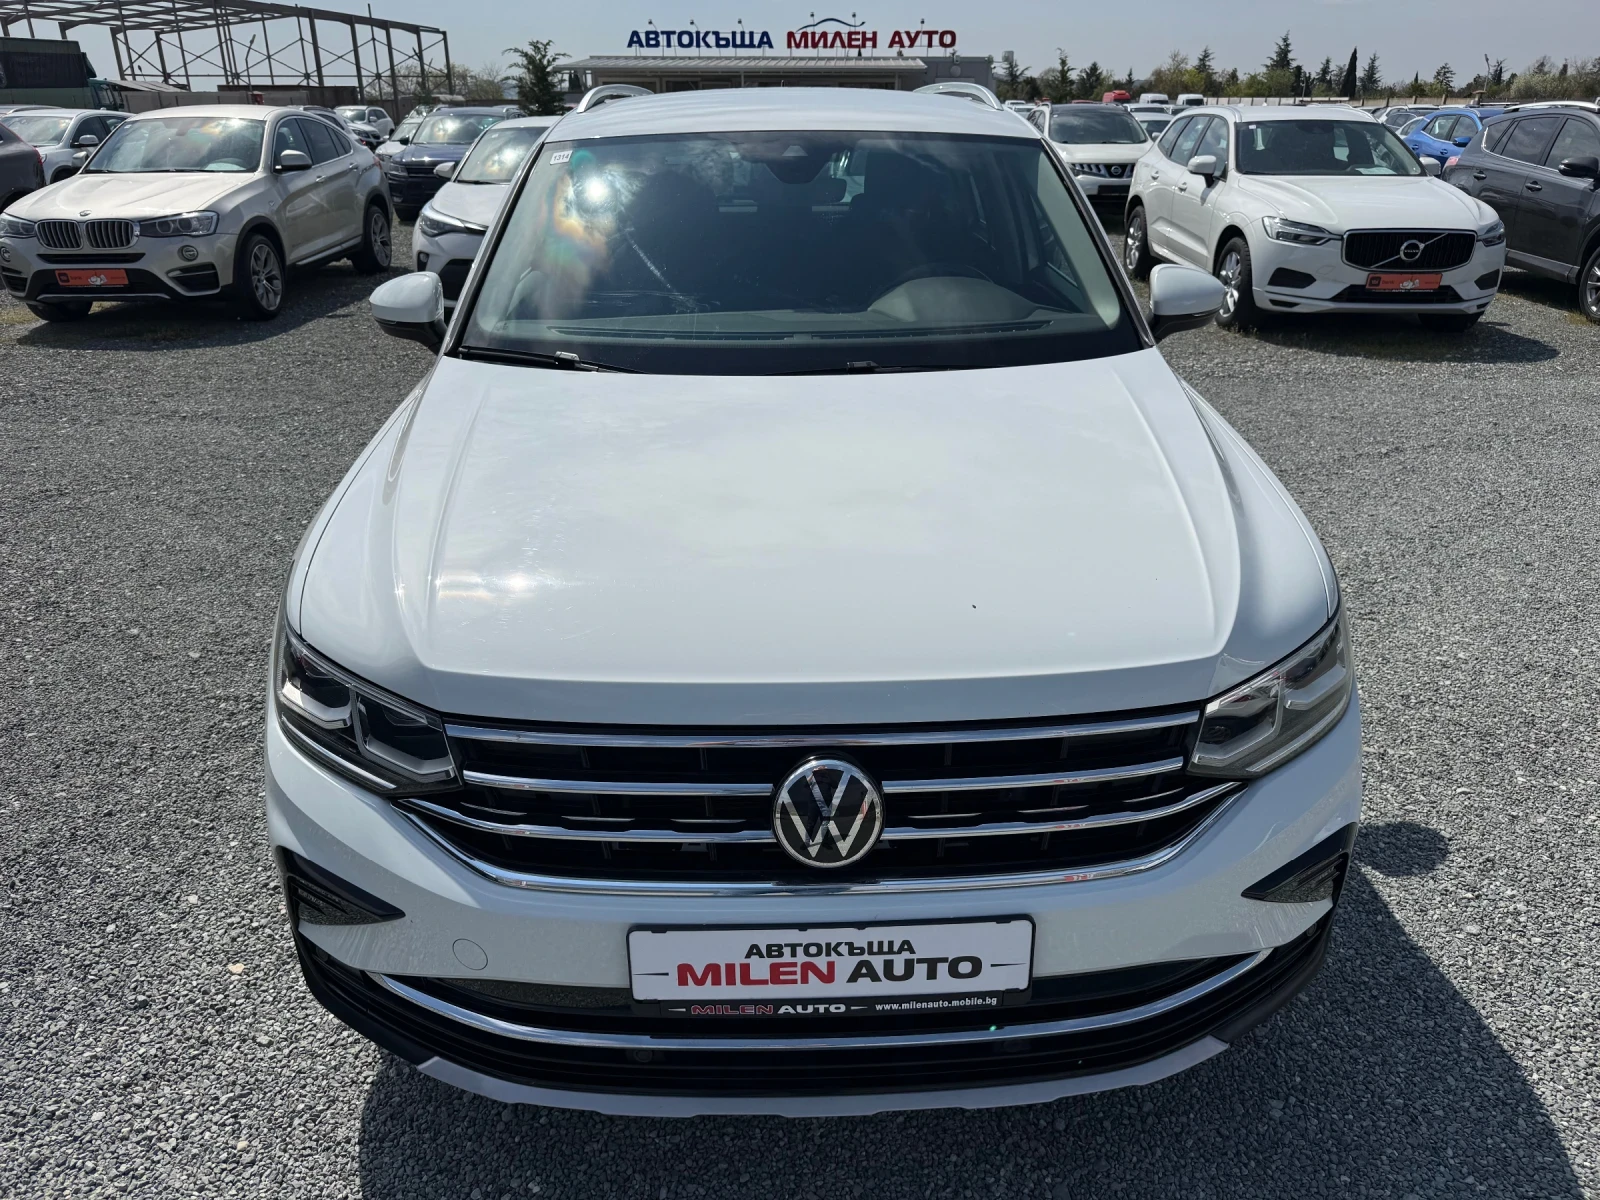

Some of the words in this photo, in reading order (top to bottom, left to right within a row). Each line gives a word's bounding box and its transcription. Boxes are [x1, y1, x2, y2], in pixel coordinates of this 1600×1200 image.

[626, 30, 774, 49] АВТОКЪЩА
[787, 31, 878, 49] МИЛЕН
[888, 30, 957, 49] АУТО
[553, 153, 570, 162] 1314
[744, 939, 917, 959] АВТОКЪЩА
[676, 961, 836, 987] MILEN
[846, 955, 983, 983] AUTO
[691, 1004, 774, 1015] MILEN
[777, 1003, 846, 1014] AUTO
[875, 996, 997, 1011] www.milenauto.mobile.bg
